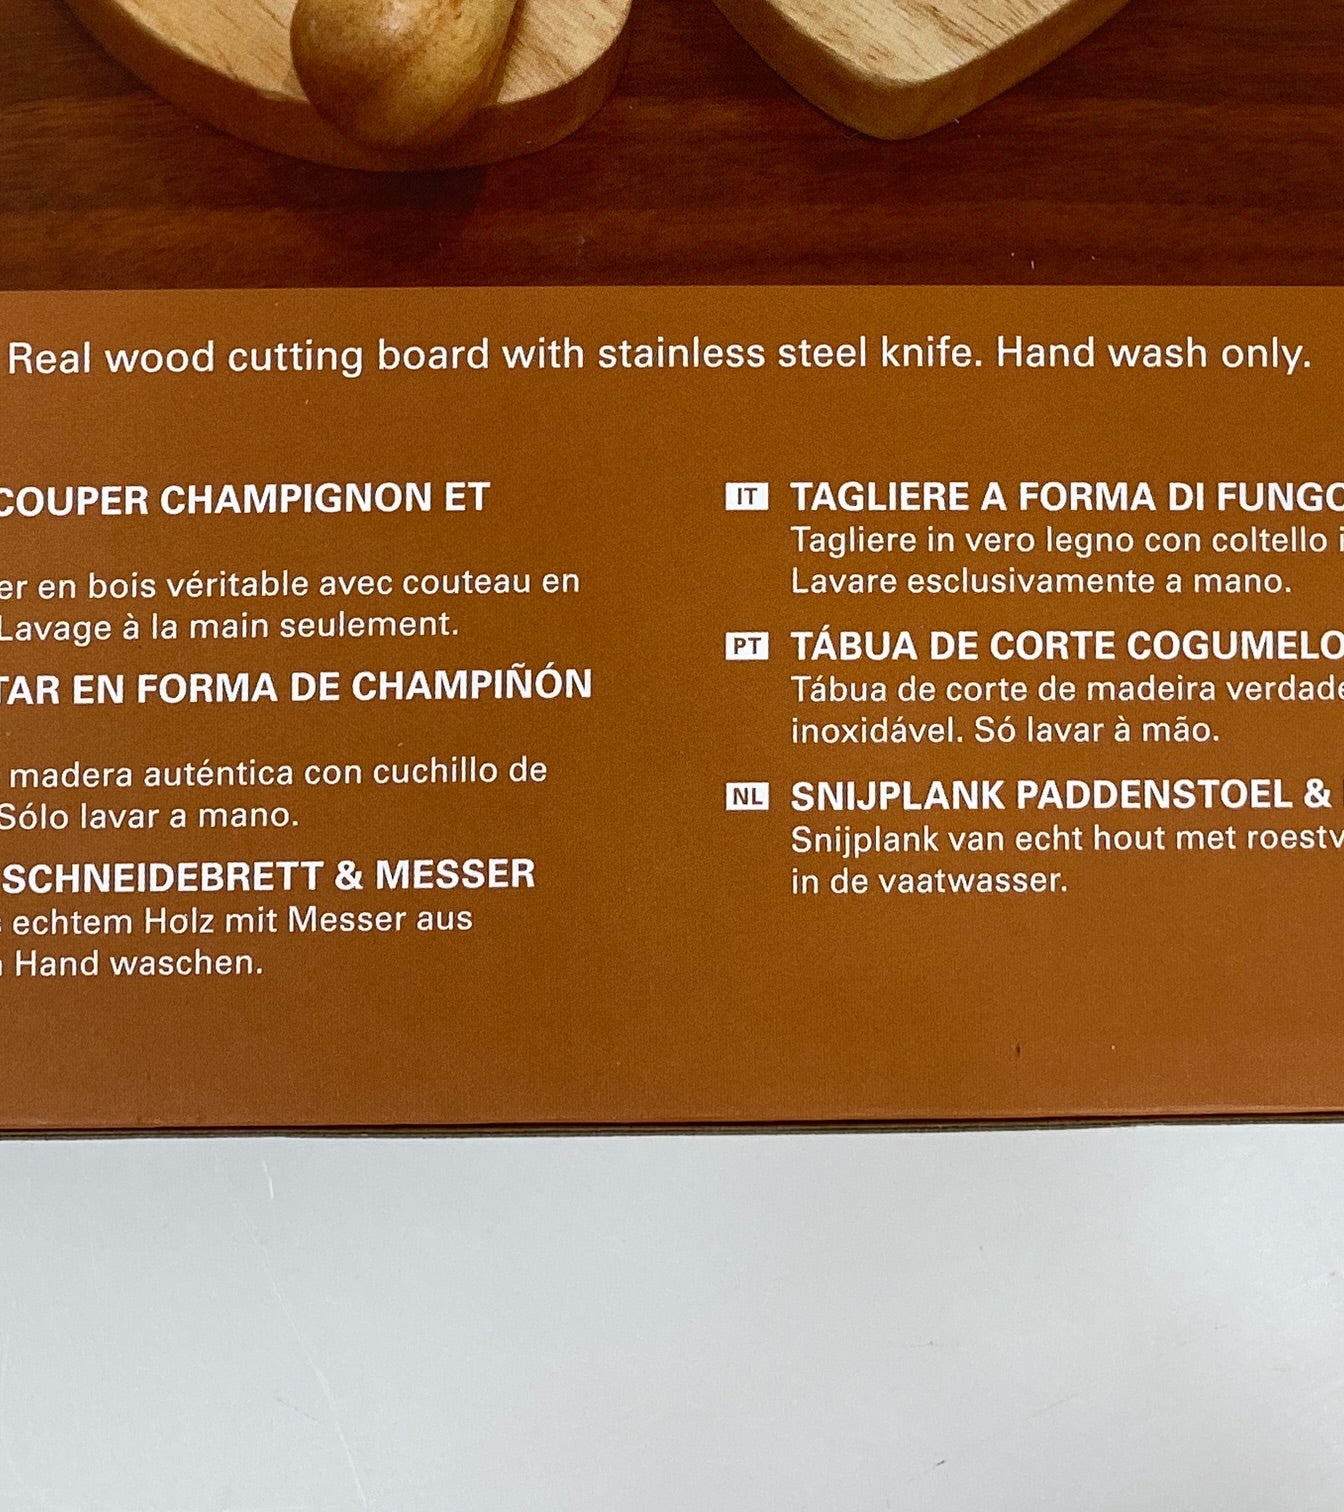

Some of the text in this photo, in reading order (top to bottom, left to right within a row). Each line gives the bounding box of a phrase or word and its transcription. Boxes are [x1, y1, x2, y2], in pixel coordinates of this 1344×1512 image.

[9, 335, 1311, 378] Real wood cutting board with stainless steel knife. Hand wash only.
[160, 482, 432, 515] CHAMPIGNON
[445, 481, 491, 511] ET
[737, 487, 758, 505] IT
[789, 481, 970, 512] TAGLIERE
[980, 481, 1008, 511] A
[1019, 481, 1157, 512] FORMA
[1169, 482, 1204, 511] DI
[790, 525, 917, 559] Tagliere
[928, 525, 955, 552] in
[965, 532, 1035, 553] vero
[1047, 525, 1134, 559] legno
[1144, 532, 1201, 553] con
[1212, 525, 1328, 553] coltello
[38, 579, 76, 600] en
[89, 571, 156, 599] bois
[166, 569, 309, 598] véritable
[319, 575, 393, 596] avec
[402, 570, 530, 595] couteau
[542, 573, 579, 594] en
[792, 566, 1291, 594] Lavare esclusivamente a mano.
[122, 612, 139, 640] à
[152, 612, 178, 640] la
[190, 611, 268, 639] main
[280, 610, 458, 638] seulement.
[733, 637, 762, 655] PT
[790, 624, 918, 661] TÁBUA
[930, 630, 979, 660] DE
[990, 630, 1116, 661] CORTE
[73, 674, 124, 705] EN
[138, 672, 278, 704] FORMA
[291, 671, 340, 702] DE
[352, 661, 592, 701] CHAMPIÑÓN
[790, 674, 887, 703] Tábua
[897, 675, 936, 702] de
[946, 678, 1028, 702] corte
[1038, 674, 1076, 702] de
[1087, 674, 1215, 701] madeira
[792, 715, 1219, 744] inoxidável. Só lavar à mão.
[10, 760, 132, 788] madera
[144, 758, 293, 787] auténtica
[304, 764, 362, 785] con
[373, 756, 498, 784] cuchillo
[509, 755, 547, 782] de
[732, 787, 763, 805] NL
[791, 780, 1006, 812] SNIJPLANK
[1017, 778, 1293, 810] PADDENSTOEL
[1303, 778, 1332, 809] &
[81, 802, 160, 830] lavar
[169, 808, 186, 829] a
[199, 807, 298, 828] mano.
[791, 824, 939, 859] Snijplank
[947, 831, 1004, 852] van
[1015, 824, 1083, 851] echt
[1094, 823, 1166, 851] hout
[1176, 826, 1237, 850] met
[2, 860, 325, 894] SCHNEIDEBRETT
[334, 860, 364, 891] &
[376, 858, 535, 890] MESSER
[792, 867, 1067, 895] in de vaatwasser.
[12, 908, 132, 936] echtem
[145, 906, 214, 934] Holz
[225, 905, 278, 933] mit
[288, 905, 407, 933] Messer
[416, 910, 473, 931] aus
[15, 949, 99, 977] Hand
[109, 948, 262, 976] waschen.
